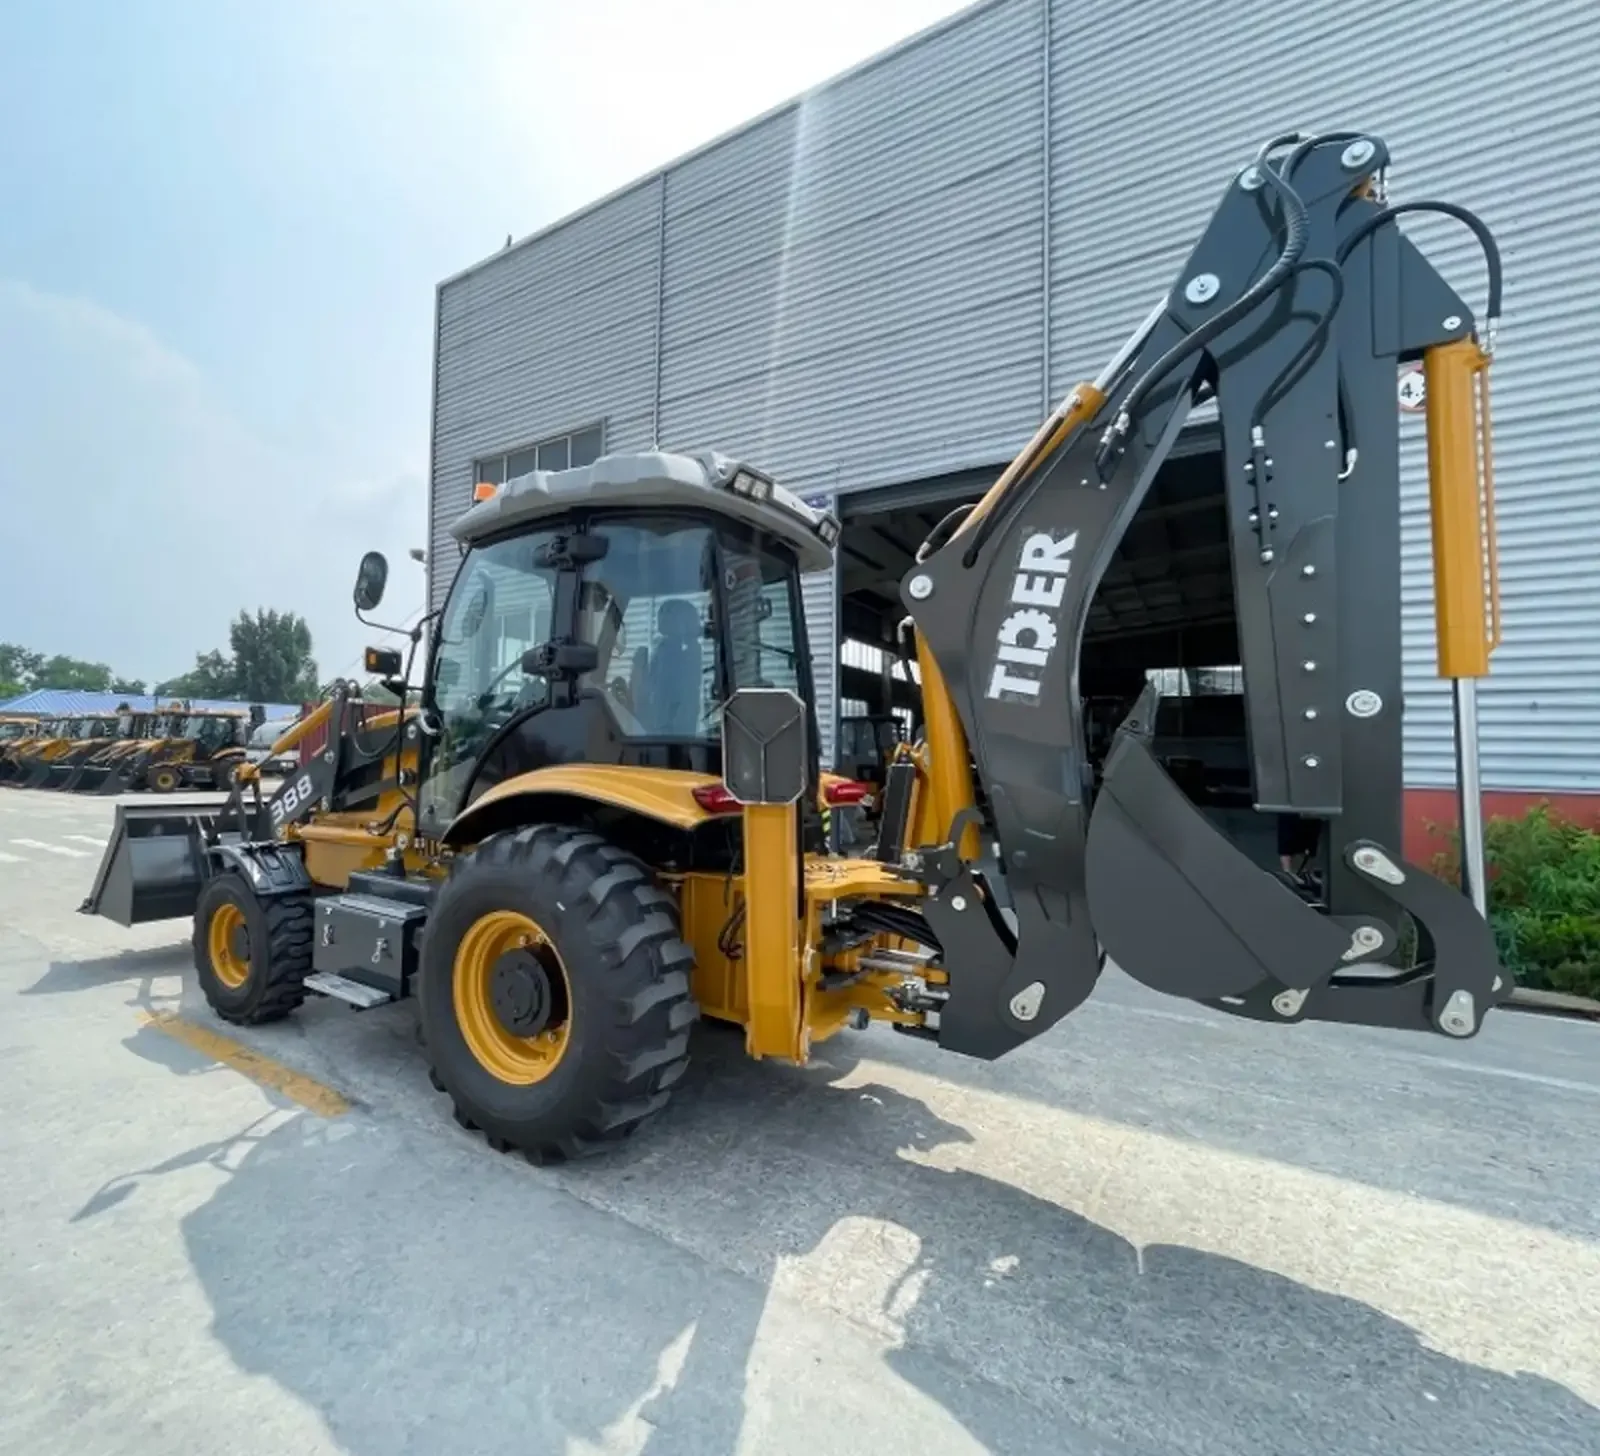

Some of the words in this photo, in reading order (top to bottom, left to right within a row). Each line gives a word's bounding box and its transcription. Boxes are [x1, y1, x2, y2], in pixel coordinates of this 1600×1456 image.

[1400, 382, 1425, 399] 4.
[987, 530, 1079, 699] TIDER
[270, 774, 313, 825] 388
